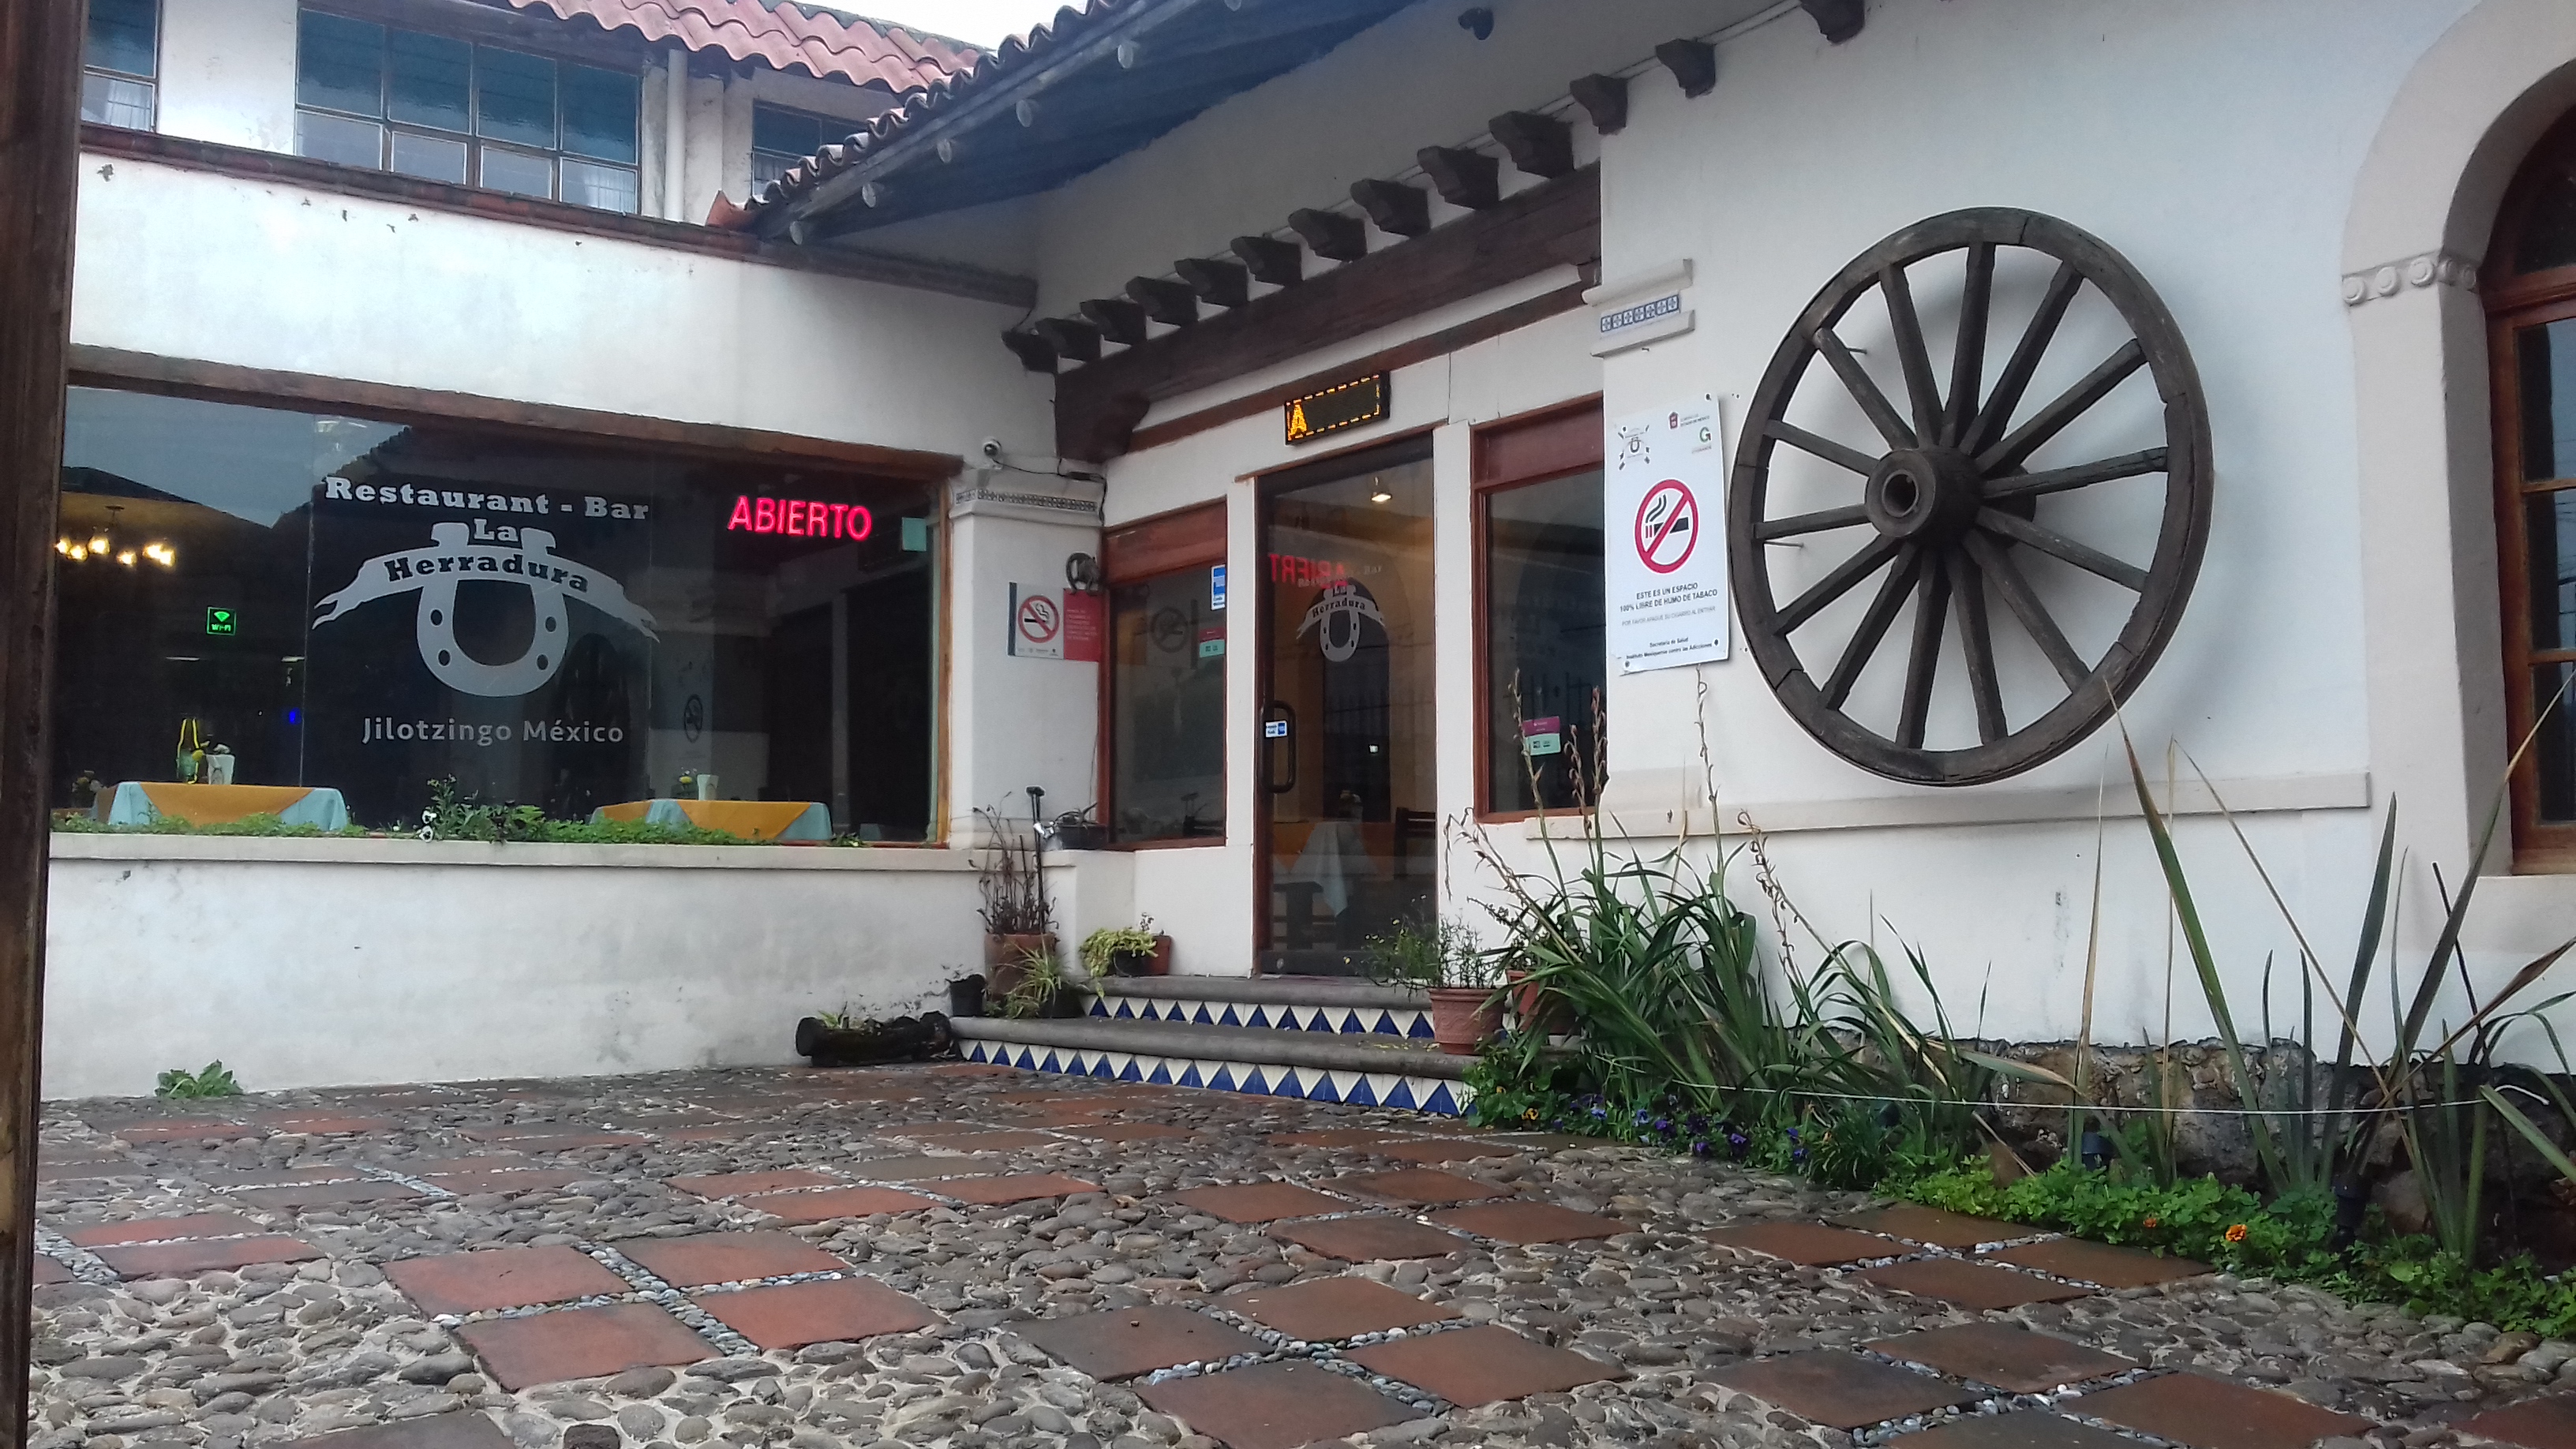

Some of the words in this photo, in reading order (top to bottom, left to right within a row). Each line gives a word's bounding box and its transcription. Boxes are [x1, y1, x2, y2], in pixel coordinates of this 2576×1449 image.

[324, 476, 549, 515] Restaurant
[585, 496, 649, 519] Bar
[473, 519, 519, 542] La
[727, 495, 872, 541] ABIERTO
[384, 553, 590, 593] Herradura
[1620, 604, 1634, 612] 100%
[1635, 600, 1653, 610] LIBRE
[1654, 598, 1662, 607] DE
[1664, 595, 1682, 605] HUMO
[1683, 593, 1691, 602] DE
[1692, 589, 1718, 600] TABACO
[1636, 590, 1652, 600] ESTE
[1653, 589, 1661, 597] ES
[1672, 582, 1698, 593] ESPACIO
[1312, 597, 1365, 618] Herradura
[361, 717, 511, 747] Jilotzingo
[523, 718, 623, 743] México
